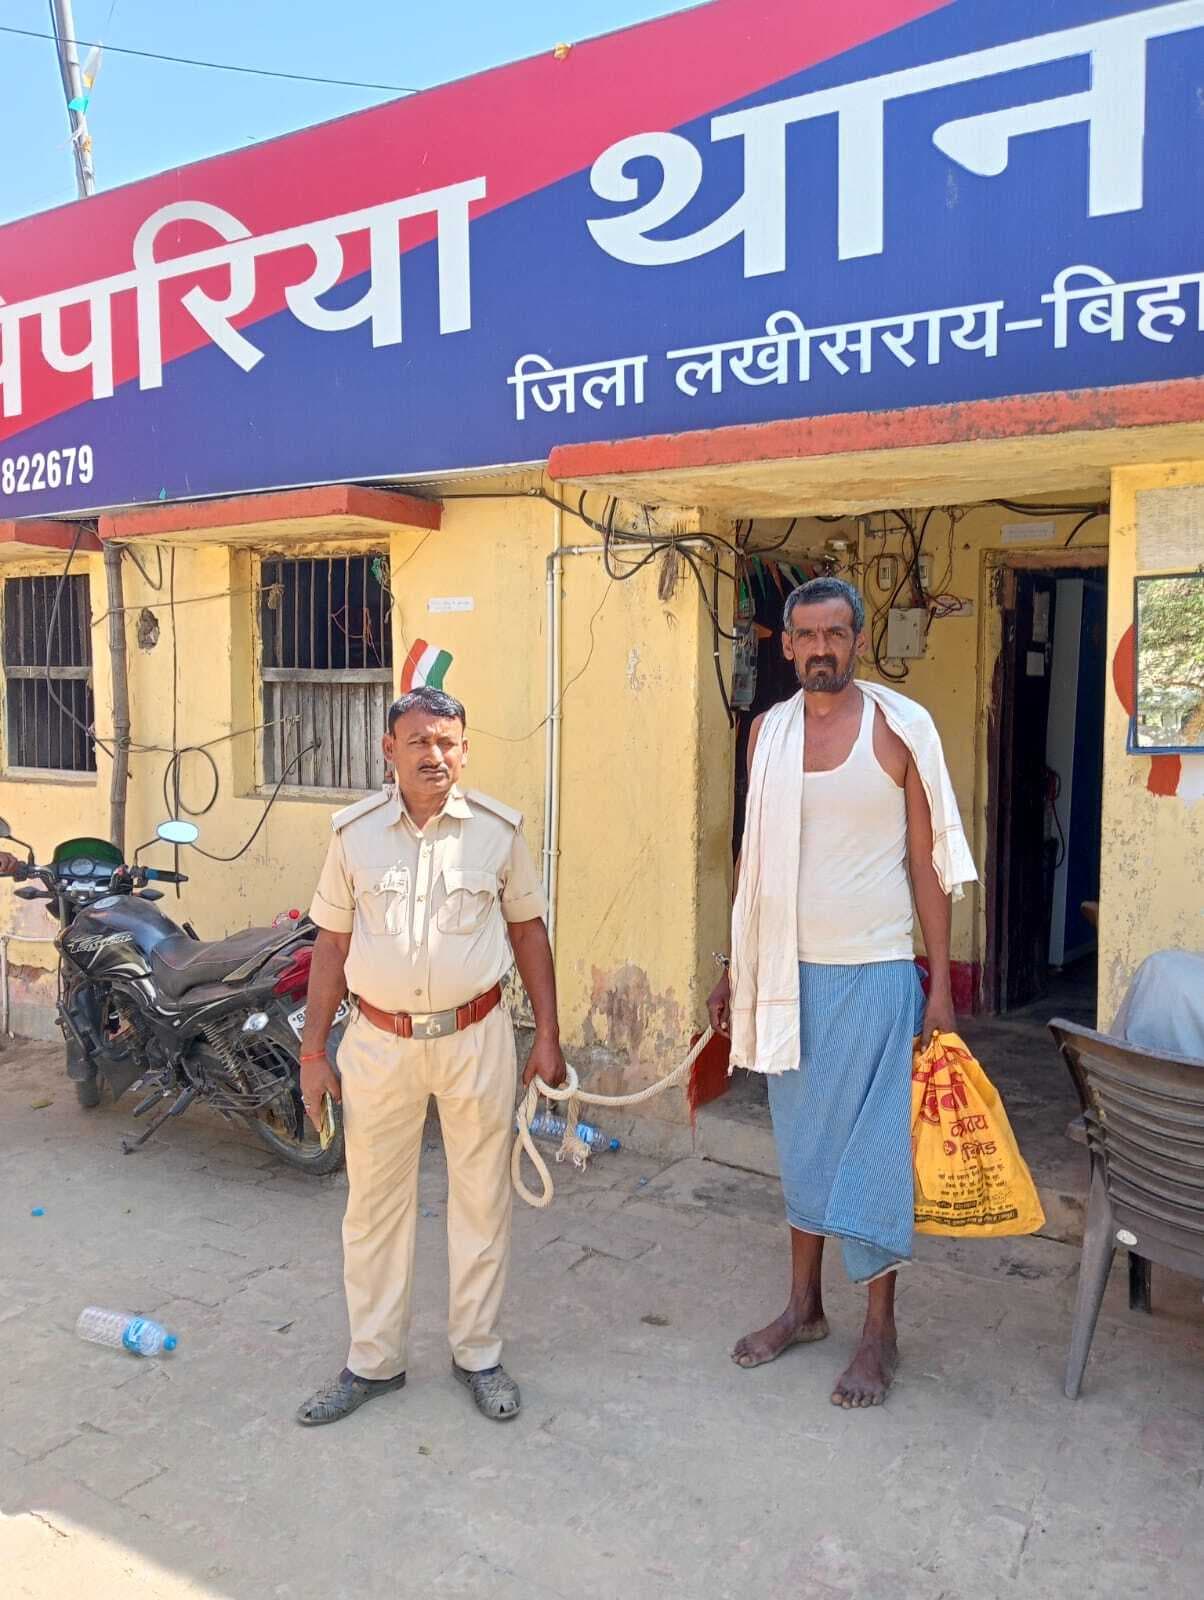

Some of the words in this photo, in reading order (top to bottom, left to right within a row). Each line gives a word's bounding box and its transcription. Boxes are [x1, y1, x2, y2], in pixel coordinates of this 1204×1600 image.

[0, 176, 486, 417] परिया
[586, 0, 1204, 279] थान
[507, 354, 648, 420] जिला
[2, 445, 94, 495] 822679
